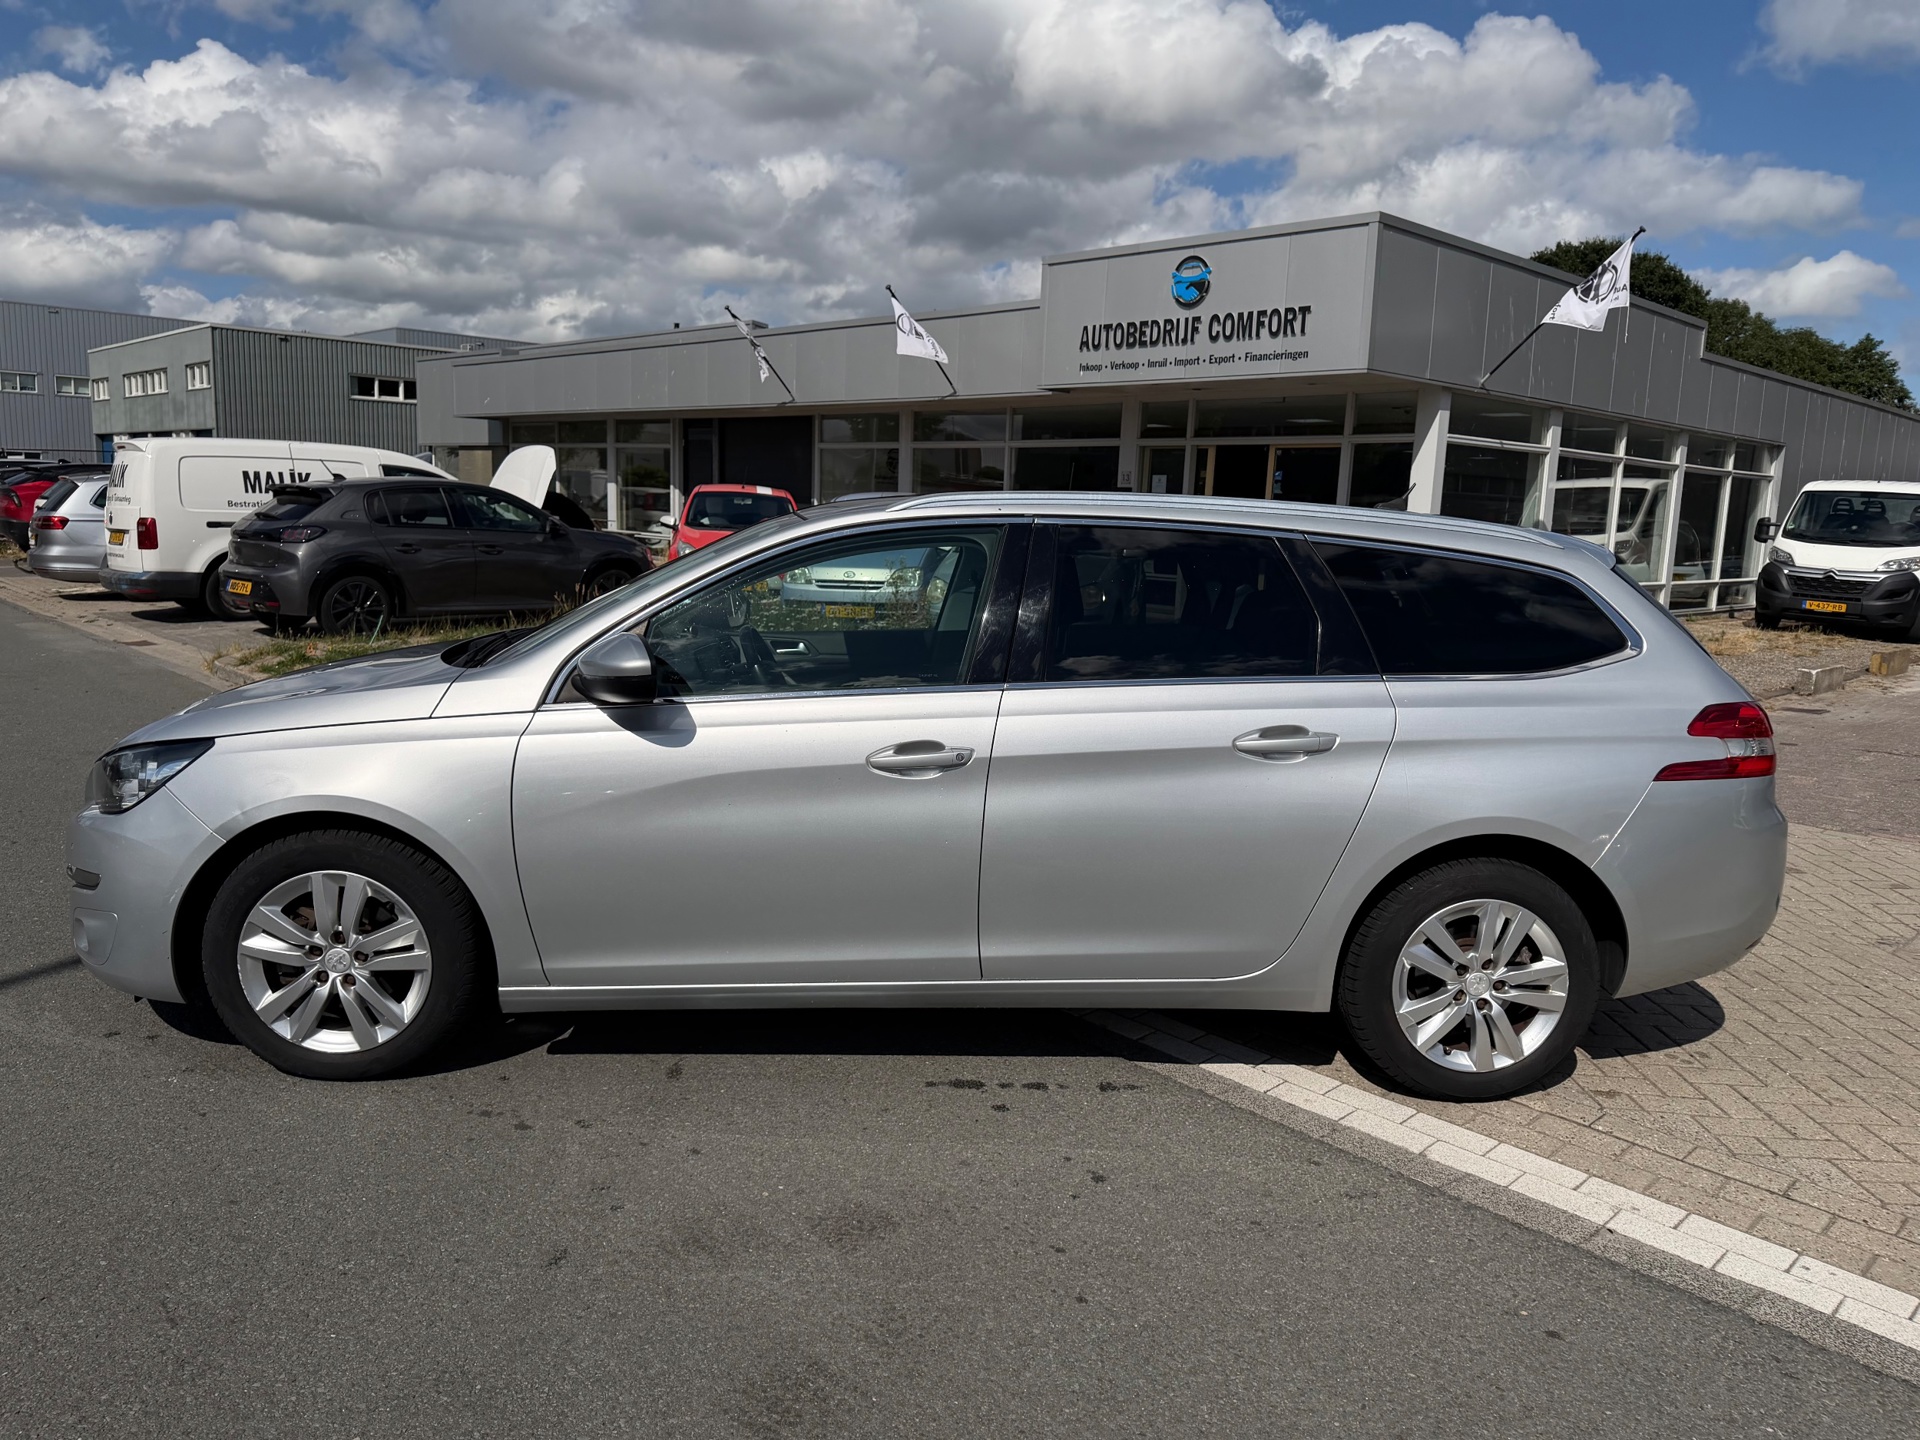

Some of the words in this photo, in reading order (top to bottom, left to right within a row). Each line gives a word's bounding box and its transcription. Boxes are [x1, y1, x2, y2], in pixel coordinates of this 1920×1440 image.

[1079, 316, 1202, 352] AUTOBEDRIJF
[1208, 305, 1312, 343] COMFORT
[1079, 363, 1103, 372] Inkoop
[1110, 361, 1140, 371] Verkoop
[1147, 358, 1168, 369] Inruil
[1174, 356, 1200, 368] Import
[1209, 353, 1235, 365] Export
[1244, 350, 1309, 363] Financieringen
[227, 499, 267, 508] Bestrati
